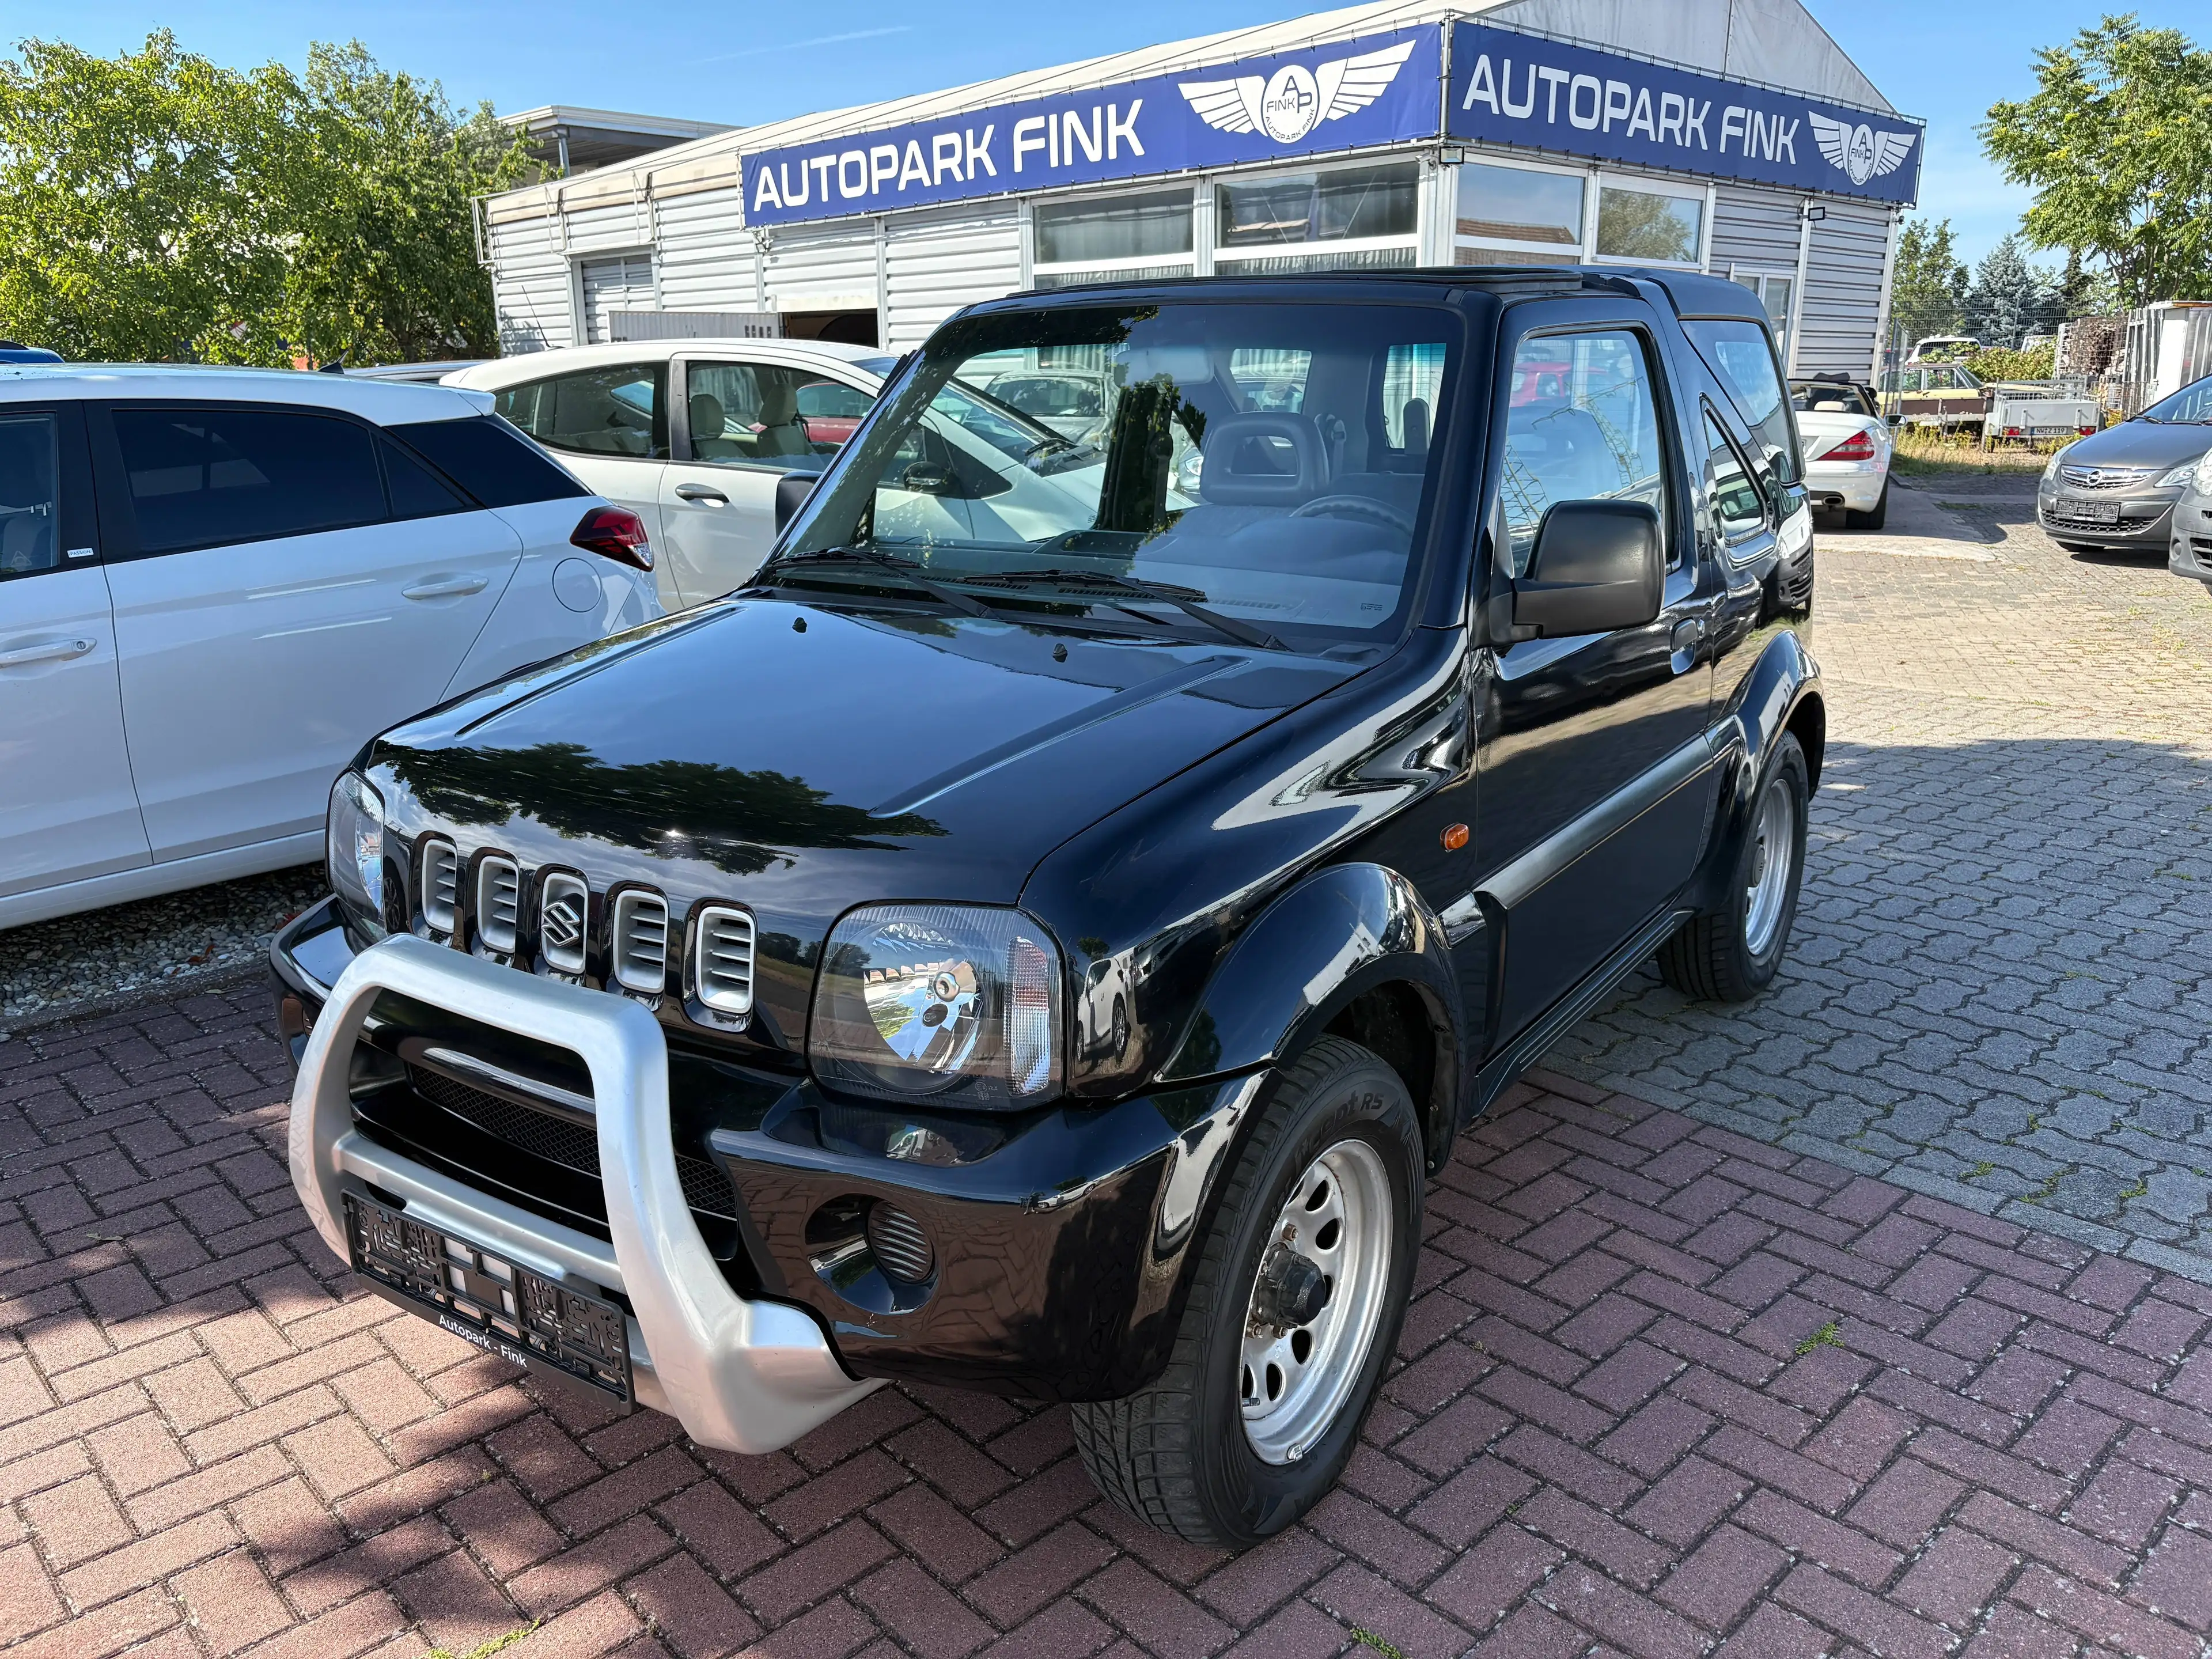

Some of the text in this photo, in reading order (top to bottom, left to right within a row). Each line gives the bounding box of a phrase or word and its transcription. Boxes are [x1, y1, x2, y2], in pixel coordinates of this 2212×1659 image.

[1267, 97, 1296, 113] FINK
[1463, 54, 1800, 165] AUTOPARK FINK
[1265, 108, 1315, 141] AUTOPARK FINK
[754, 99, 1145, 212] AUTOPARK FINK
[1850, 148, 1865, 160] FINK
[1360, 1092, 1384, 1112] RS
[440, 1315, 491, 1350] Autopark
[501, 1344, 528, 1368] Fink
